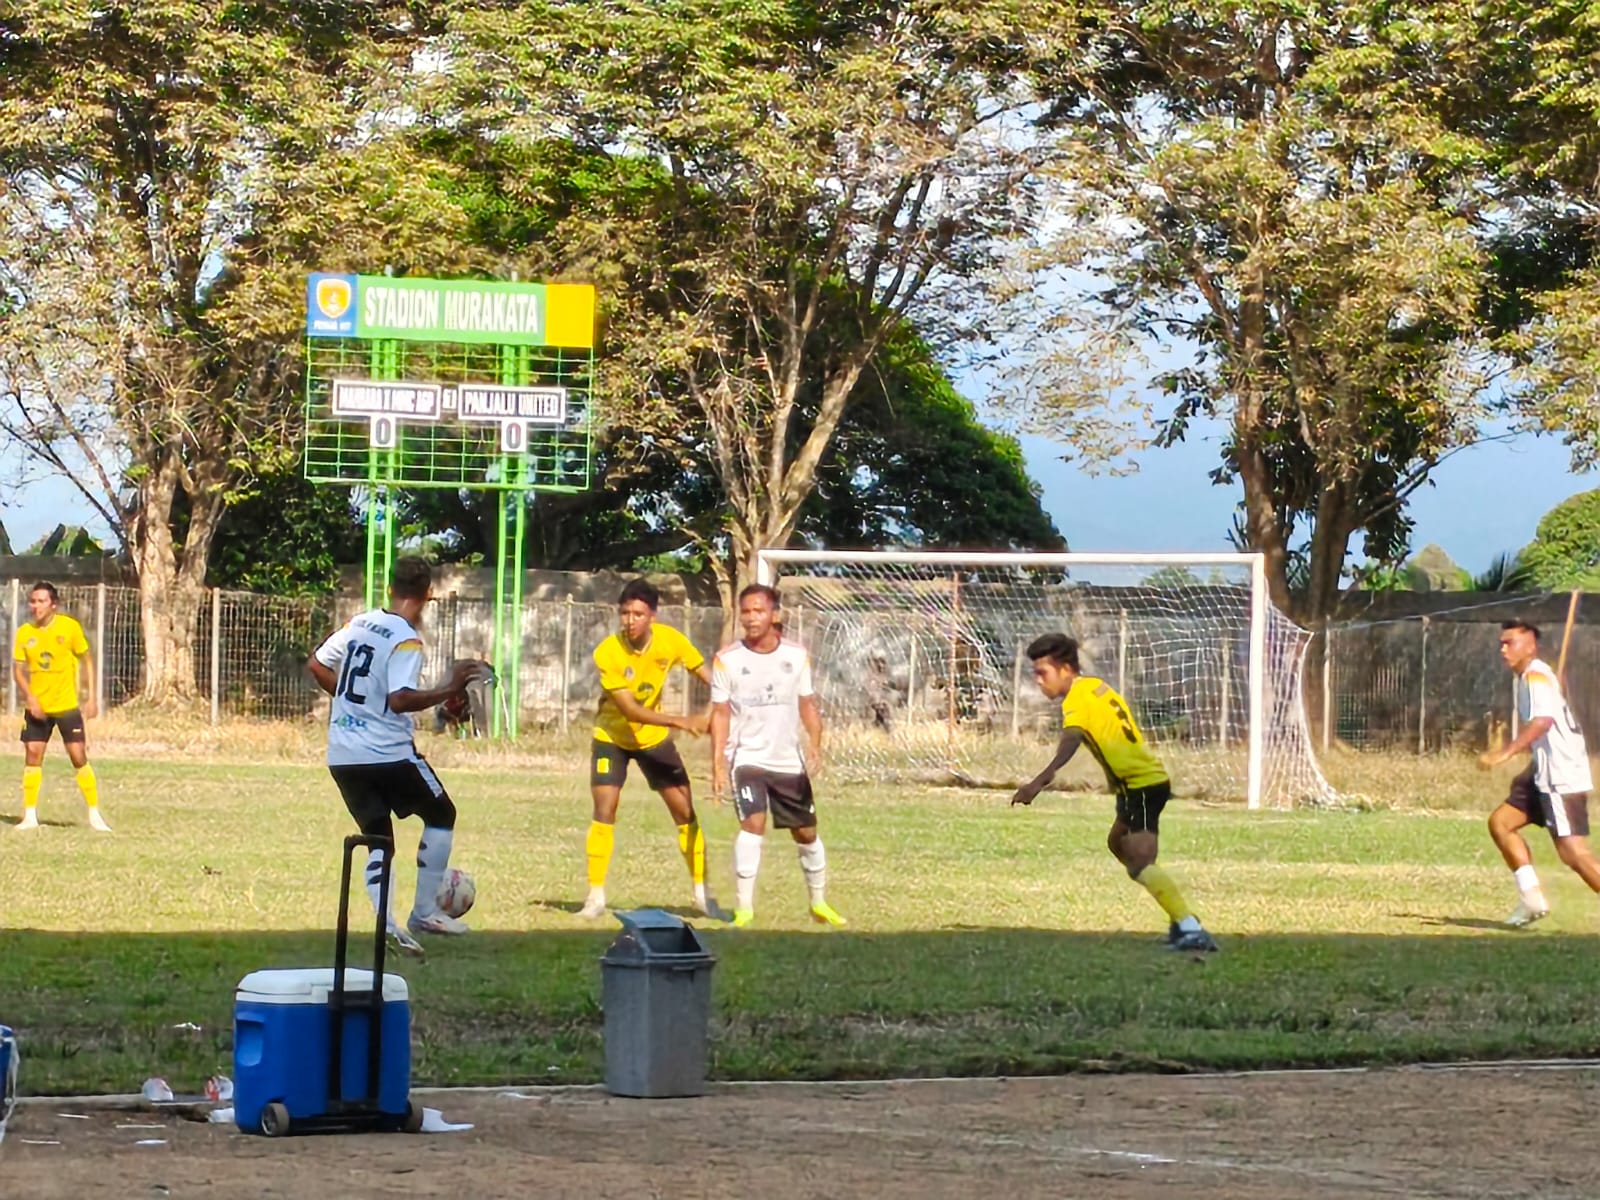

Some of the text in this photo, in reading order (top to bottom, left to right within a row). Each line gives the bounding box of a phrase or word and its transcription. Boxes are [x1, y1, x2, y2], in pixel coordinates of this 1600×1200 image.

[365, 286, 539, 333] STADION MURAKATA
[464, 391, 516, 415] PANJALU
[518, 393, 559, 417] UNITED
[375, 417, 391, 445] 0
[505, 422, 522, 449] 0
[337, 639, 376, 705] 12
[1109, 698, 1138, 744] 3
[741, 786, 754, 803] 4
